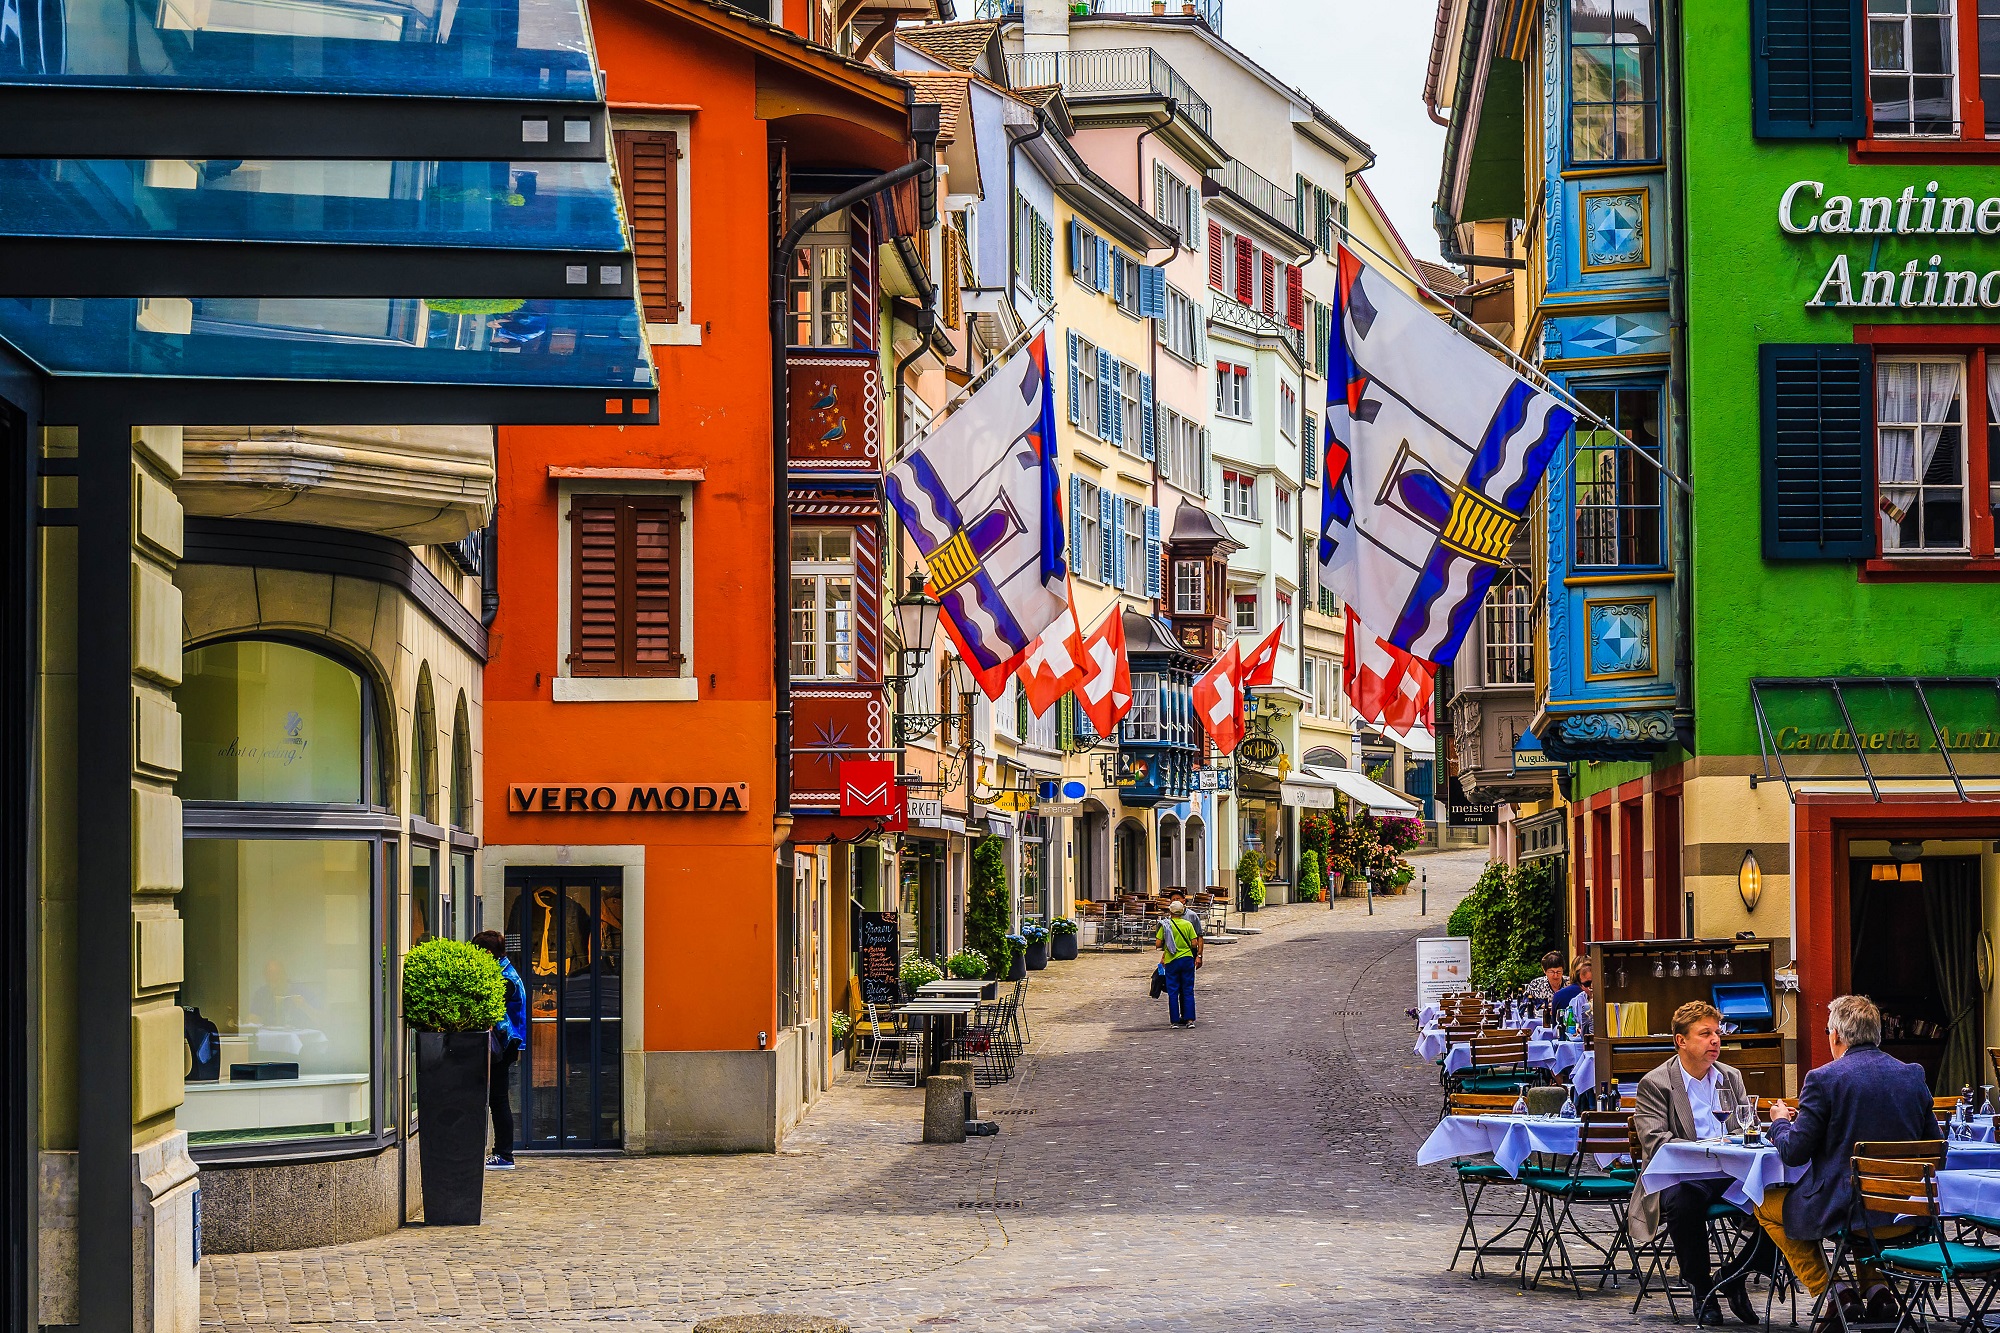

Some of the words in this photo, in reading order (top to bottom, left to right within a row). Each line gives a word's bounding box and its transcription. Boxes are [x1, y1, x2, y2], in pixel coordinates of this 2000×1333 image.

[1778, 180, 2000, 235] Cantine
[1775, 726, 1920, 750] Cantinetta
[1243, 741, 1276, 759] BÖHNY
[514, 786, 617, 810] VERO
[1043, 804, 1072, 814] trenta
[1451, 803, 1495, 813] meister
[865, 933, 894, 946] Yogurt
